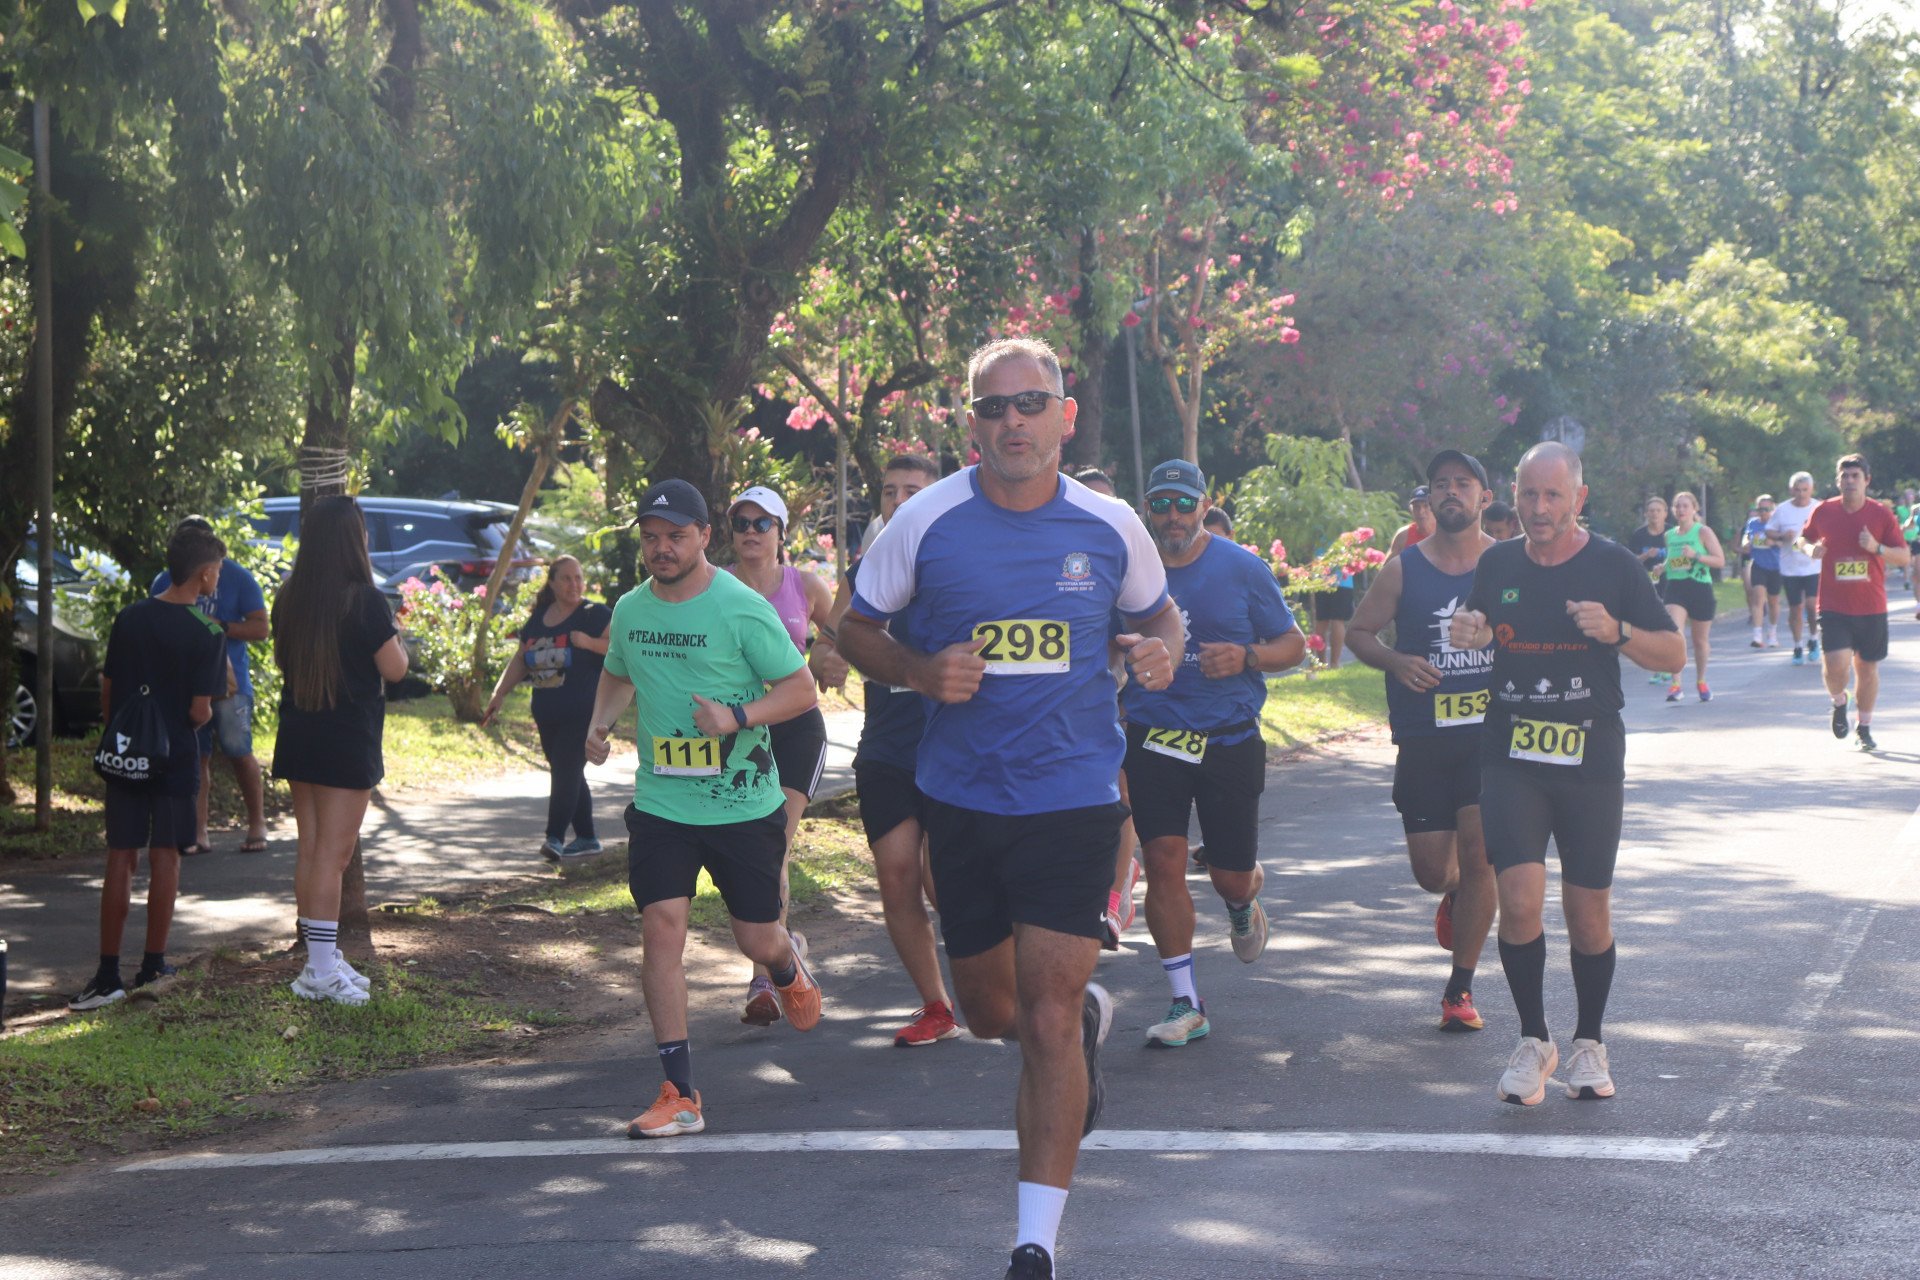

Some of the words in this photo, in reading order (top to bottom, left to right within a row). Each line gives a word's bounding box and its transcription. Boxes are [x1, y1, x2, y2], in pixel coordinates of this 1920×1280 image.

[1837, 562, 1866, 576] 243
[628, 629, 707, 647] #TEAMRENCK
[977, 623, 1065, 661] 298
[642, 649, 687, 660] RUNNING
[1440, 693, 1489, 717] 153
[1148, 730, 1204, 755] 228
[1515, 720, 1581, 756] 300
[94, 749, 150, 771] ICOOB
[660, 740, 712, 766] 111
